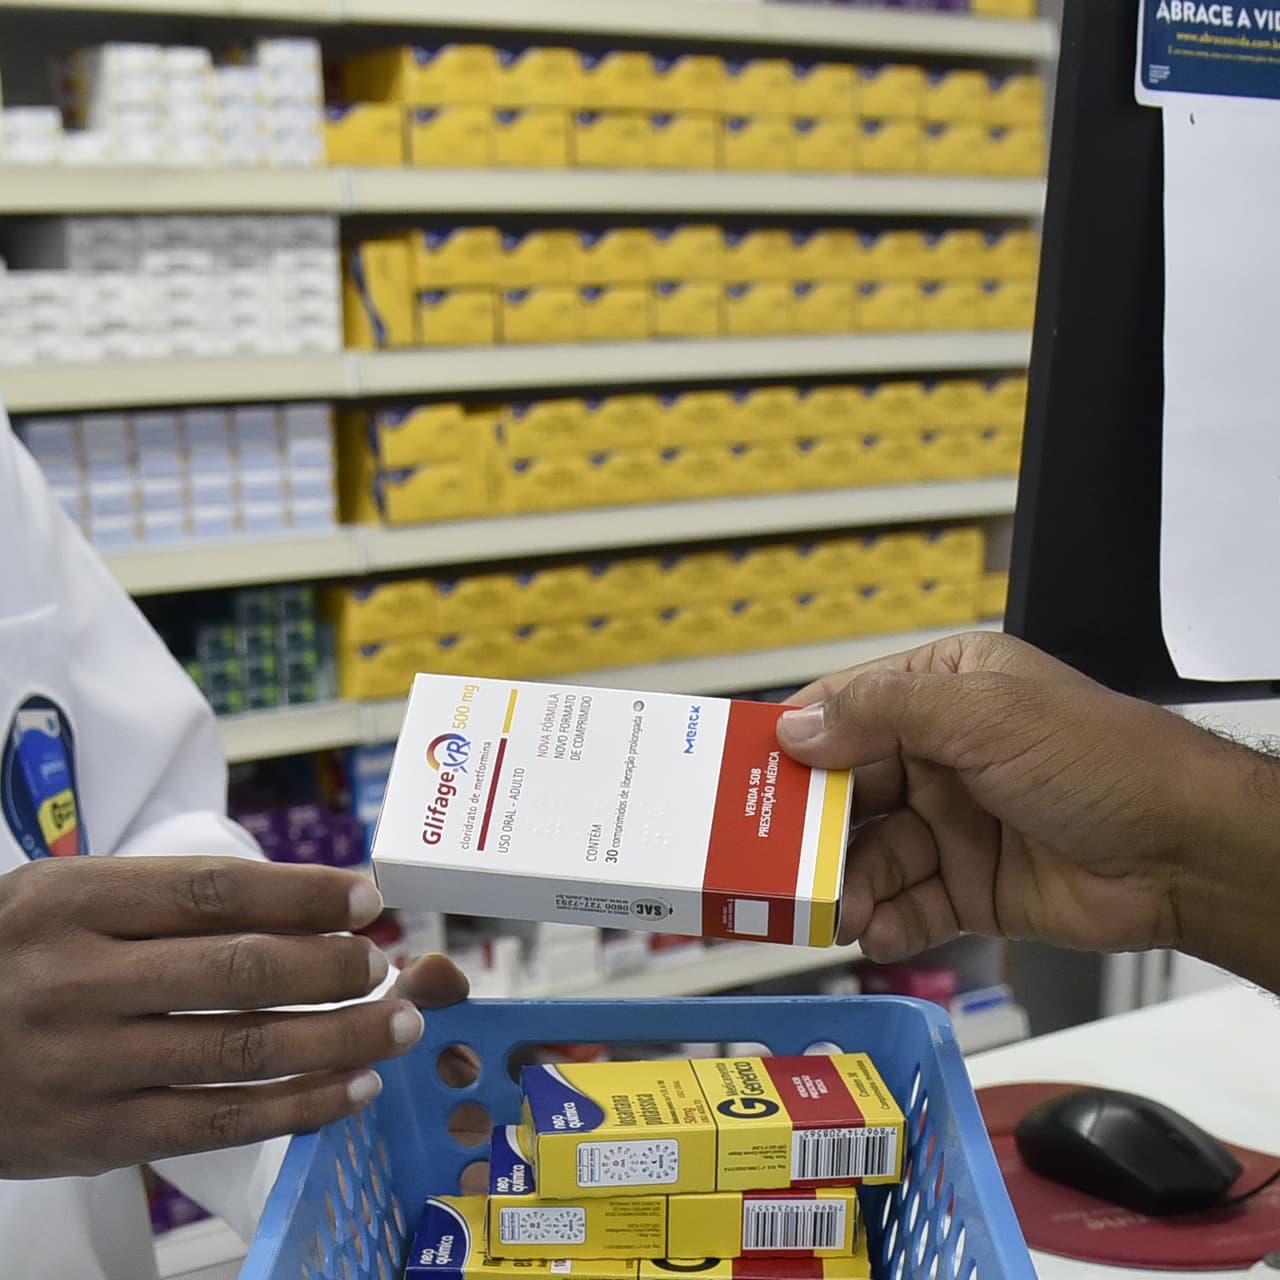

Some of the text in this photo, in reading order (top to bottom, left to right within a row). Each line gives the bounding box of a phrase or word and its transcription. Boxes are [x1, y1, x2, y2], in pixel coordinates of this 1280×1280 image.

[1155, 0, 1234, 27] ABRACE
[1237, 8, 1251, 29] A
[536, 693, 560, 759] NOVA FÓRMULA
[554, 694, 577, 760] NOVO FORMATO
[570, 695, 593, 761] DE COMPRIMIDO
[422, 684, 480, 845] Glifage 500 mg
[460, 741, 492, 850] cloridrato de metformina
[604, 715, 644, 864] 30 comprimidos de liberação prolongada
[745, 768, 762, 817] VENDA SOB
[758, 751, 780, 838] PRESCRIÇÃO MÉDICA
[498, 767, 525, 853] USO ORAL ADULTO
[585, 823, 603, 862] CONTÉM
[604, 902, 629, 913] 0800
[636, 902, 662, 917] SAC
[731, 1061, 765, 1096] Genérico
[552, 1102, 585, 1129] neo química
[611, 1094, 638, 1126] losartana
[633, 1093, 670, 1125] potássica
[716, 1097, 780, 1119] G
[512, 1165, 528, 1192] química
[419, 1235, 455, 1264] neo química
